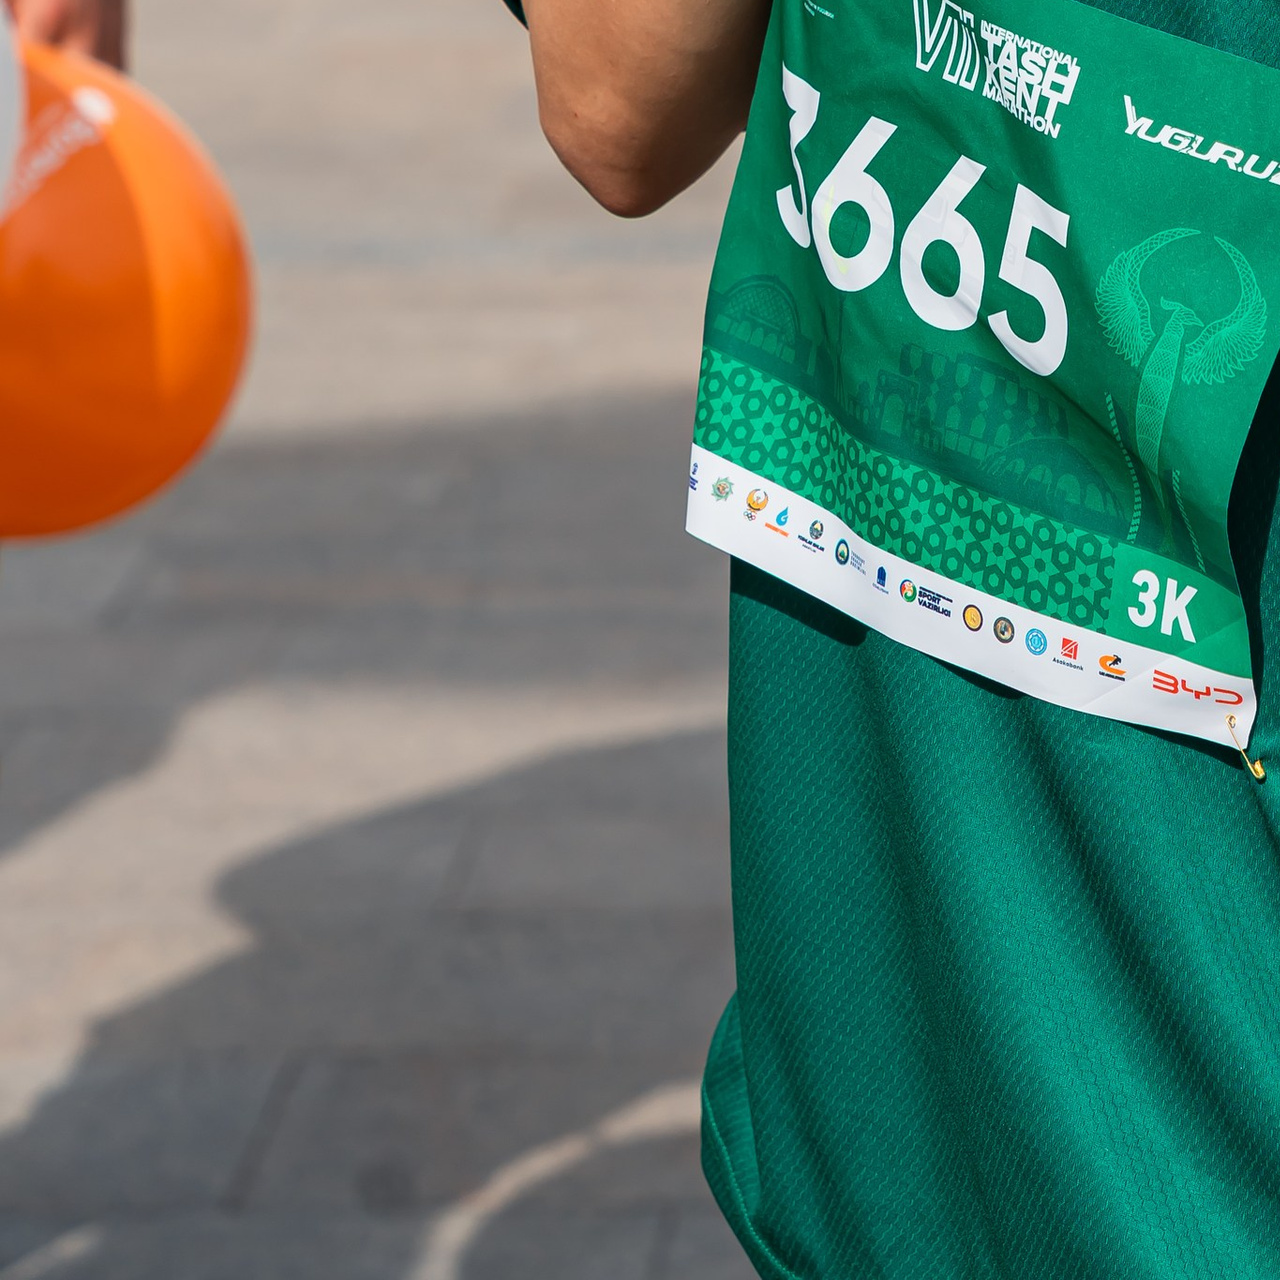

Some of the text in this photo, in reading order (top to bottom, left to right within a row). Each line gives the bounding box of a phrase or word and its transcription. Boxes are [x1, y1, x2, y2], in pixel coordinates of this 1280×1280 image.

[981, 19, 1078, 72] INTERNATIONAL
[981, 34, 1081, 105] TASH
[982, 80, 1061, 139] MARATHON
[984, 55, 1070, 124] KENT
[776, 60, 1070, 376] 3665
[918, 590, 942, 605] SPORT
[918, 598, 952, 617] VAZIRLIGI
[1127, 569, 1198, 643] 3K
[1052, 657, 1084, 672] Asakabank
[1152, 669, 1244, 705] BYD
